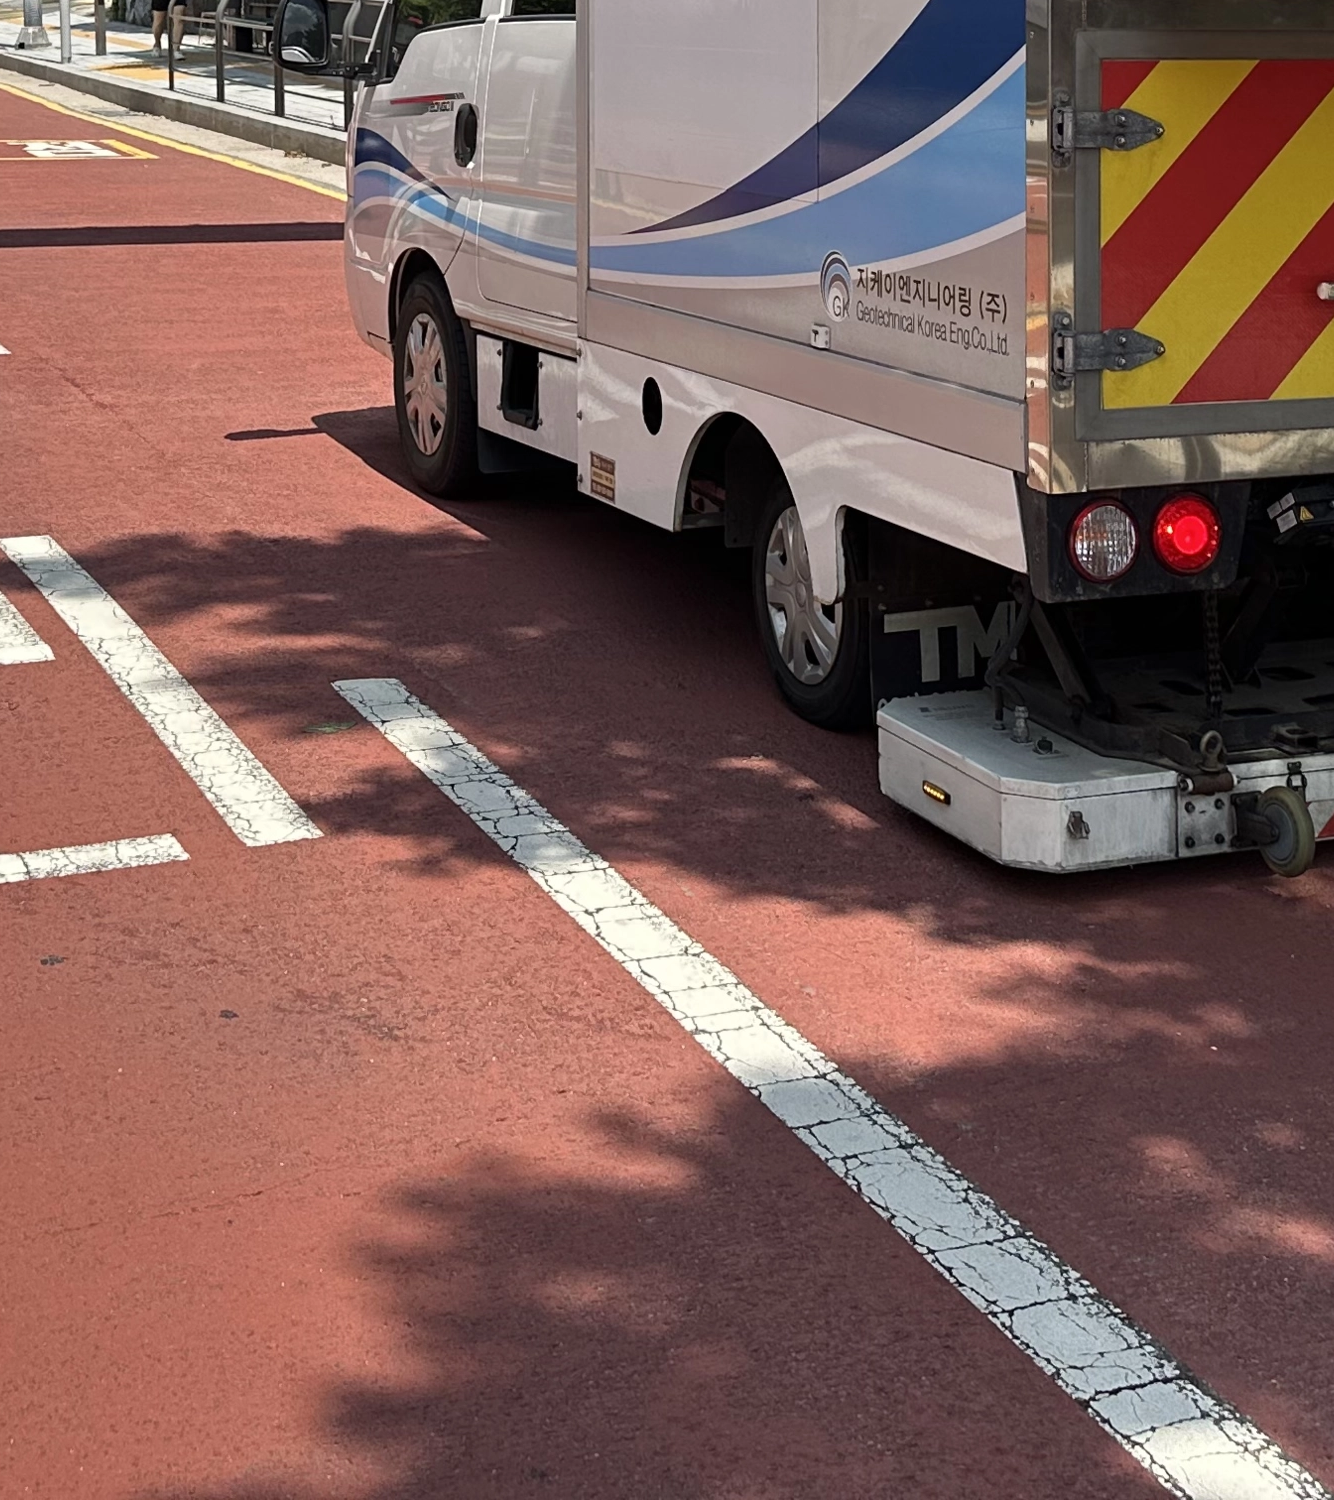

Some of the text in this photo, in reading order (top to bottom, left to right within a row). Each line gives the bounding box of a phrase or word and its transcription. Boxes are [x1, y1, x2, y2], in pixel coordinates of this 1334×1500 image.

[856, 267, 1007, 325] 지케이엔지니어링 (주)
[856, 300, 915, 333] Geotechnical
[917, 314, 947, 341] Korea
